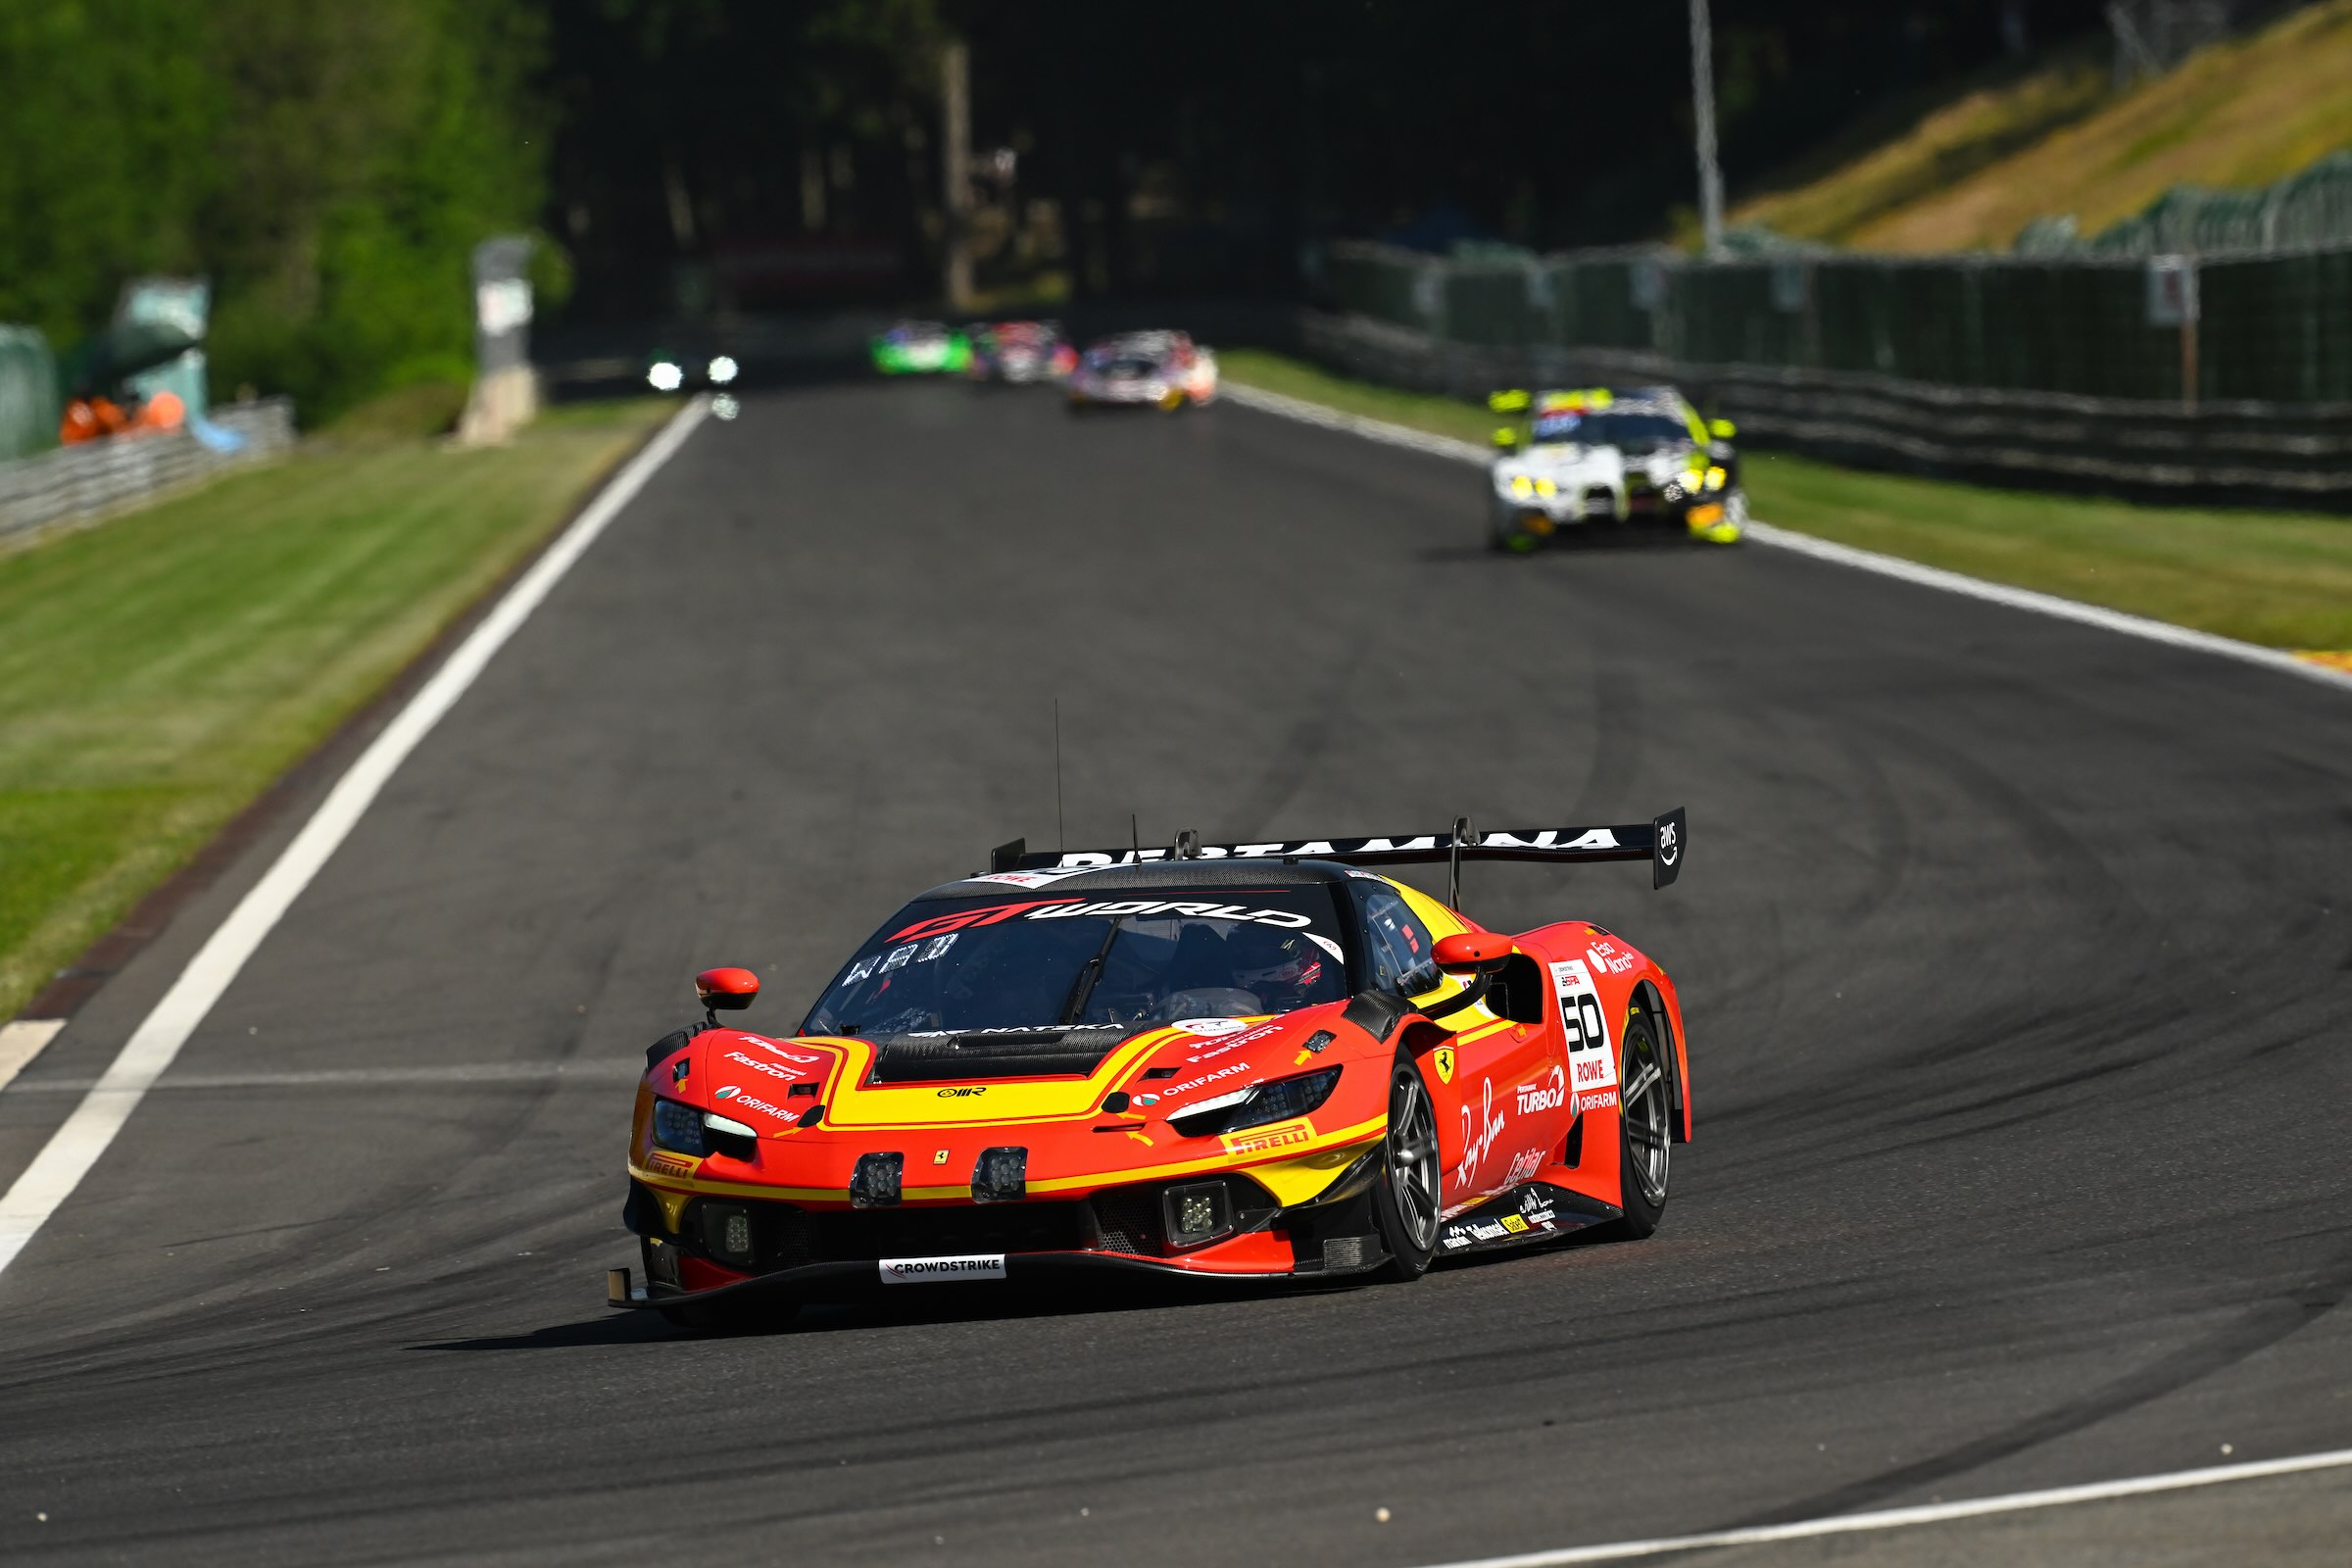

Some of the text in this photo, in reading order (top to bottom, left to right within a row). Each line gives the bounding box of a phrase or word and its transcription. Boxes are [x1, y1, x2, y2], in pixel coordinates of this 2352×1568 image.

[1659, 821, 1677, 849] aws
[1023, 901, 1312, 929] WORLD
[1560, 993, 1604, 1054] 50
[1186, 1026, 1284, 1063] Fastron
[723, 1051, 797, 1081] Fastron
[1163, 1061, 1250, 1096] ORIFARM
[1577, 1059, 1604, 1083] ROWE
[736, 1095, 801, 1123] ORIFARM
[1517, 1087, 1557, 1115] TURBO
[1581, 1091, 1617, 1111] ORIFARM
[1230, 1124, 1309, 1155] PIRELLI
[646, 1152, 693, 1179] PIRELLI
[1503, 1147, 1546, 1185] Cetilar
[893, 1259, 1001, 1274] CROWDSTRIKE
